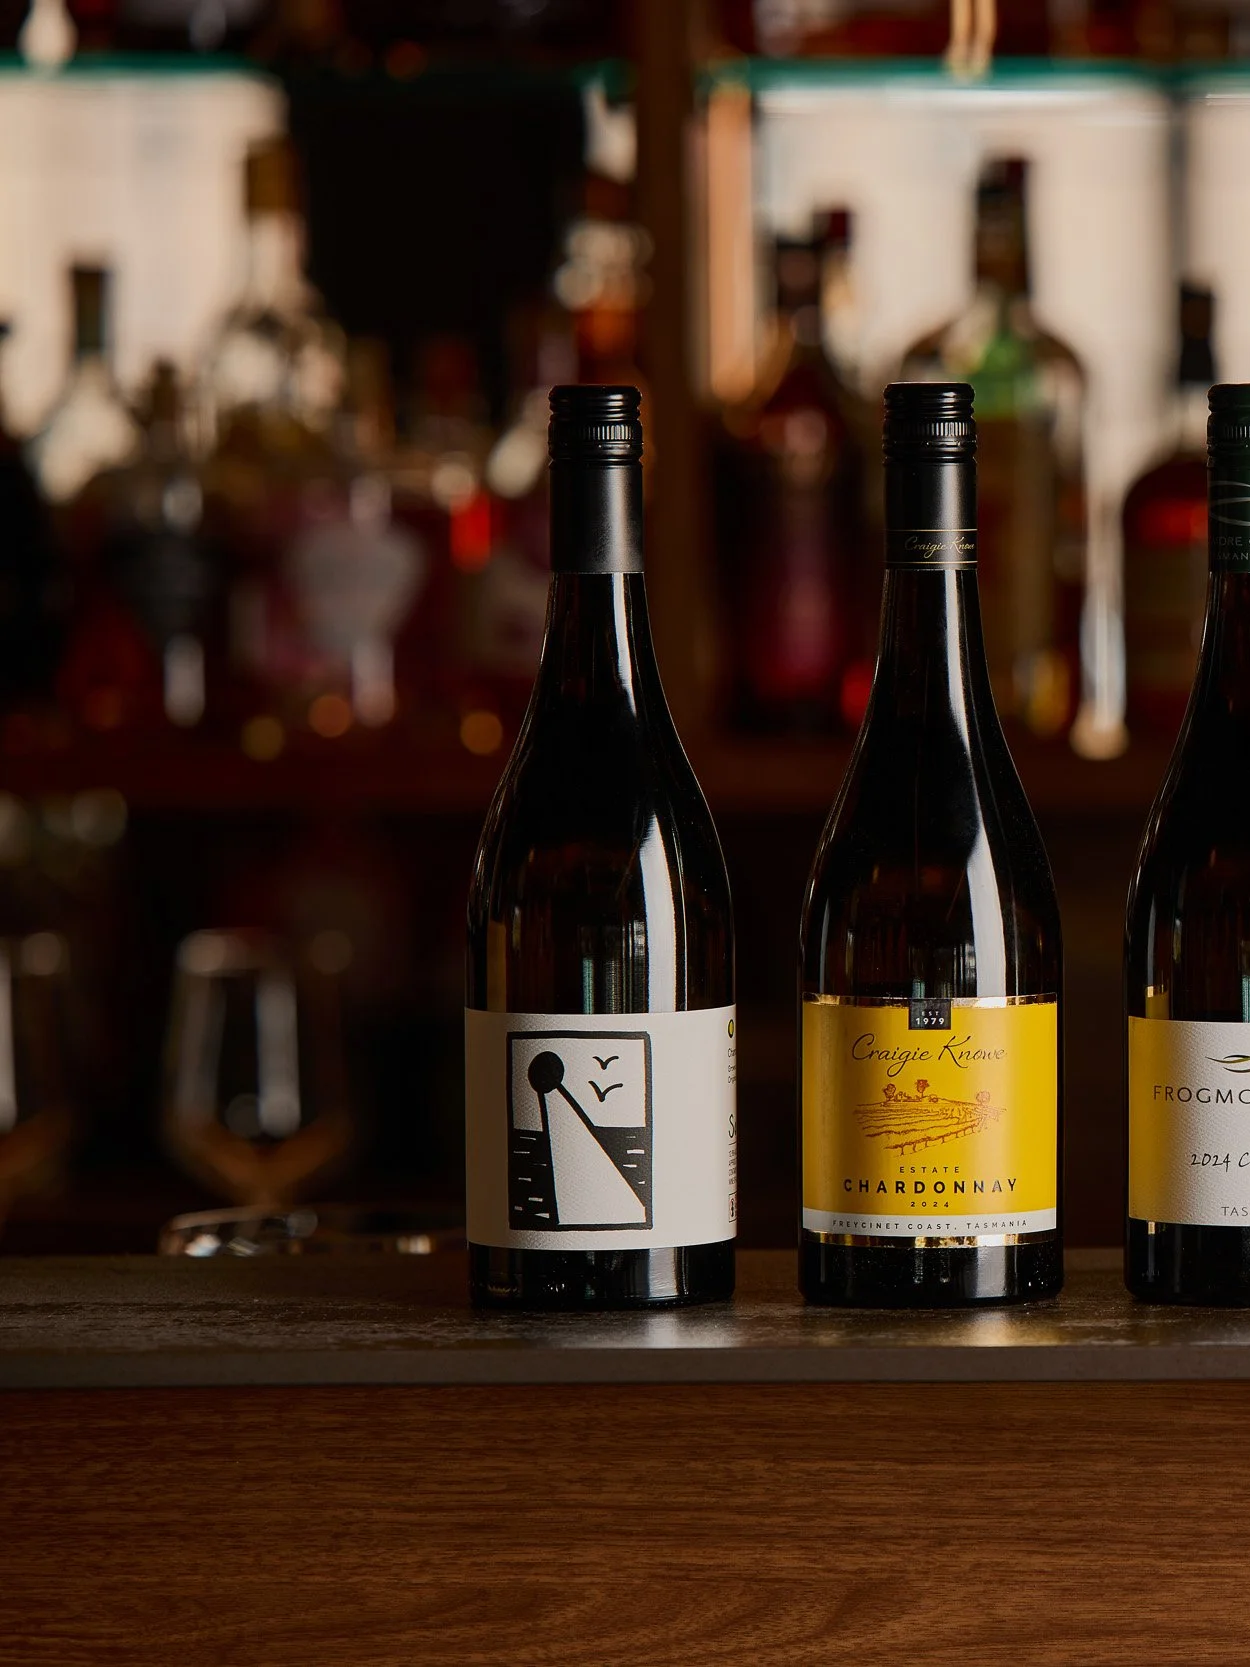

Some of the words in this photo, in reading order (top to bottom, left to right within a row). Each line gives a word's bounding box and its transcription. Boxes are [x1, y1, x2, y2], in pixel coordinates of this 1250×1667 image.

[915, 1017, 945, 1025] 1979
[851, 1033, 933, 1077] Craigie
[938, 1035, 1008, 1069] Knowe
[898, 1165, 961, 1174] ESTATE
[1190, 1152, 1232, 1173] 2024
[843, 1178, 1018, 1194] CHARDONNAY
[832, 1219, 900, 1230] FREYCINET
[907, 1222, 958, 1231] COAST,
[966, 1219, 1028, 1229] TASMANIA
